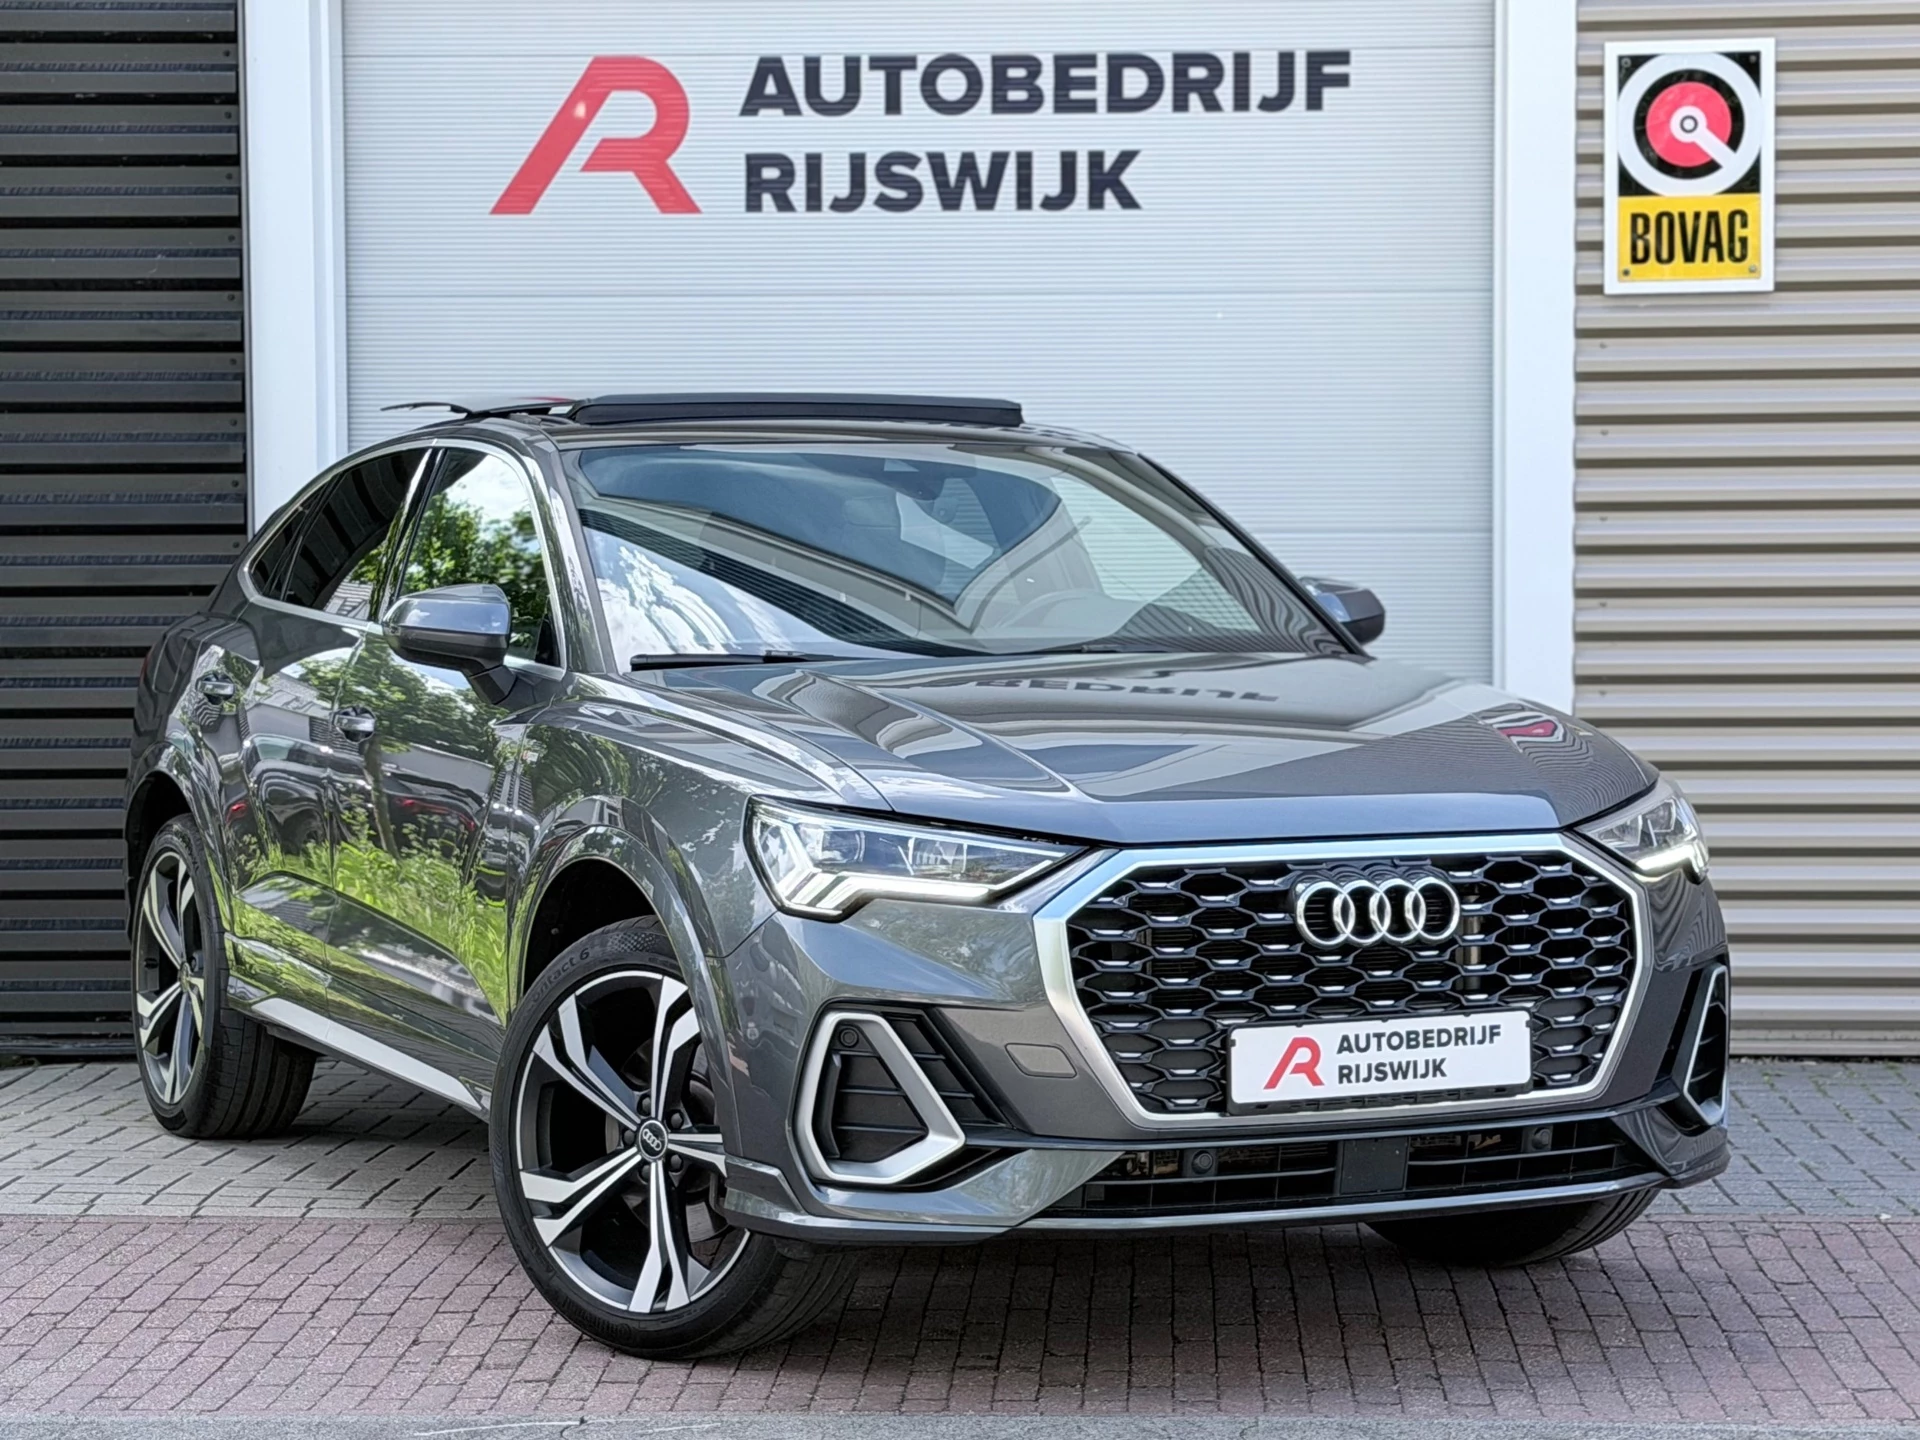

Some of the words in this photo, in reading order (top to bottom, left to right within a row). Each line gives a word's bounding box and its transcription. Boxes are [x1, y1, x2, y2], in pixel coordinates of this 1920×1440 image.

[740, 50, 1351, 117] AUTOBEDRIJF
[743, 149, 1143, 214] RIJSWIJK
[1630, 208, 1749, 266] BOVAG
[579, 947, 590, 961] 6
[1336, 1024, 1502, 1055] AUTOBEDRIJF
[1337, 1057, 1448, 1085] RIJSWIJK
